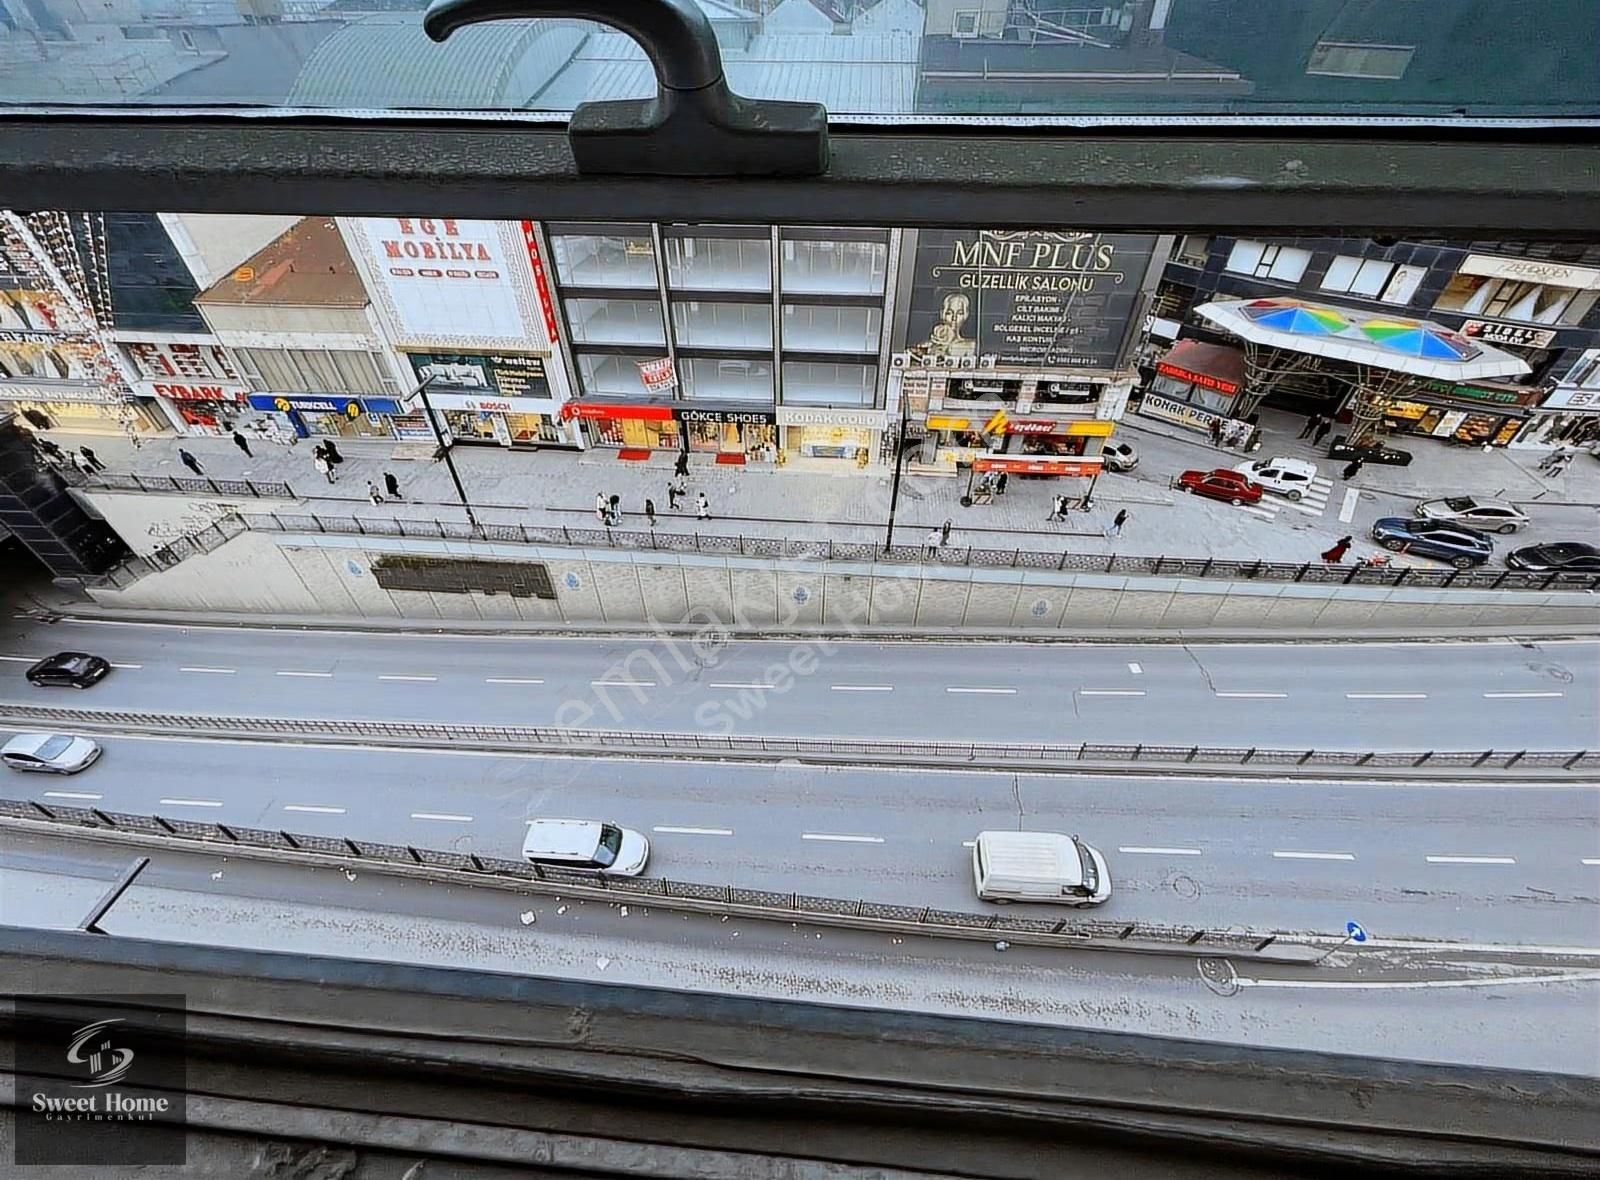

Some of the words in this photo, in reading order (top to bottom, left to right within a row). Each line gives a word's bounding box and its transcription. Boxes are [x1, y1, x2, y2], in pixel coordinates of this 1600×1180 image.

[398, 218, 459, 236] EGE
[382, 237, 491, 261] MOBİLYA
[951, 240, 1025, 267] MNF
[1030, 242, 1113, 271] PLUS
[960, 273, 1030, 290] GÜZELLİK
[1032, 275, 1094, 292] SALONU
[480, 402, 511, 410] BOSCH
[1145, 395, 1185, 416] KONAK
[727, 413, 766, 423] SHOES
[785, 412, 832, 423] KODAK
